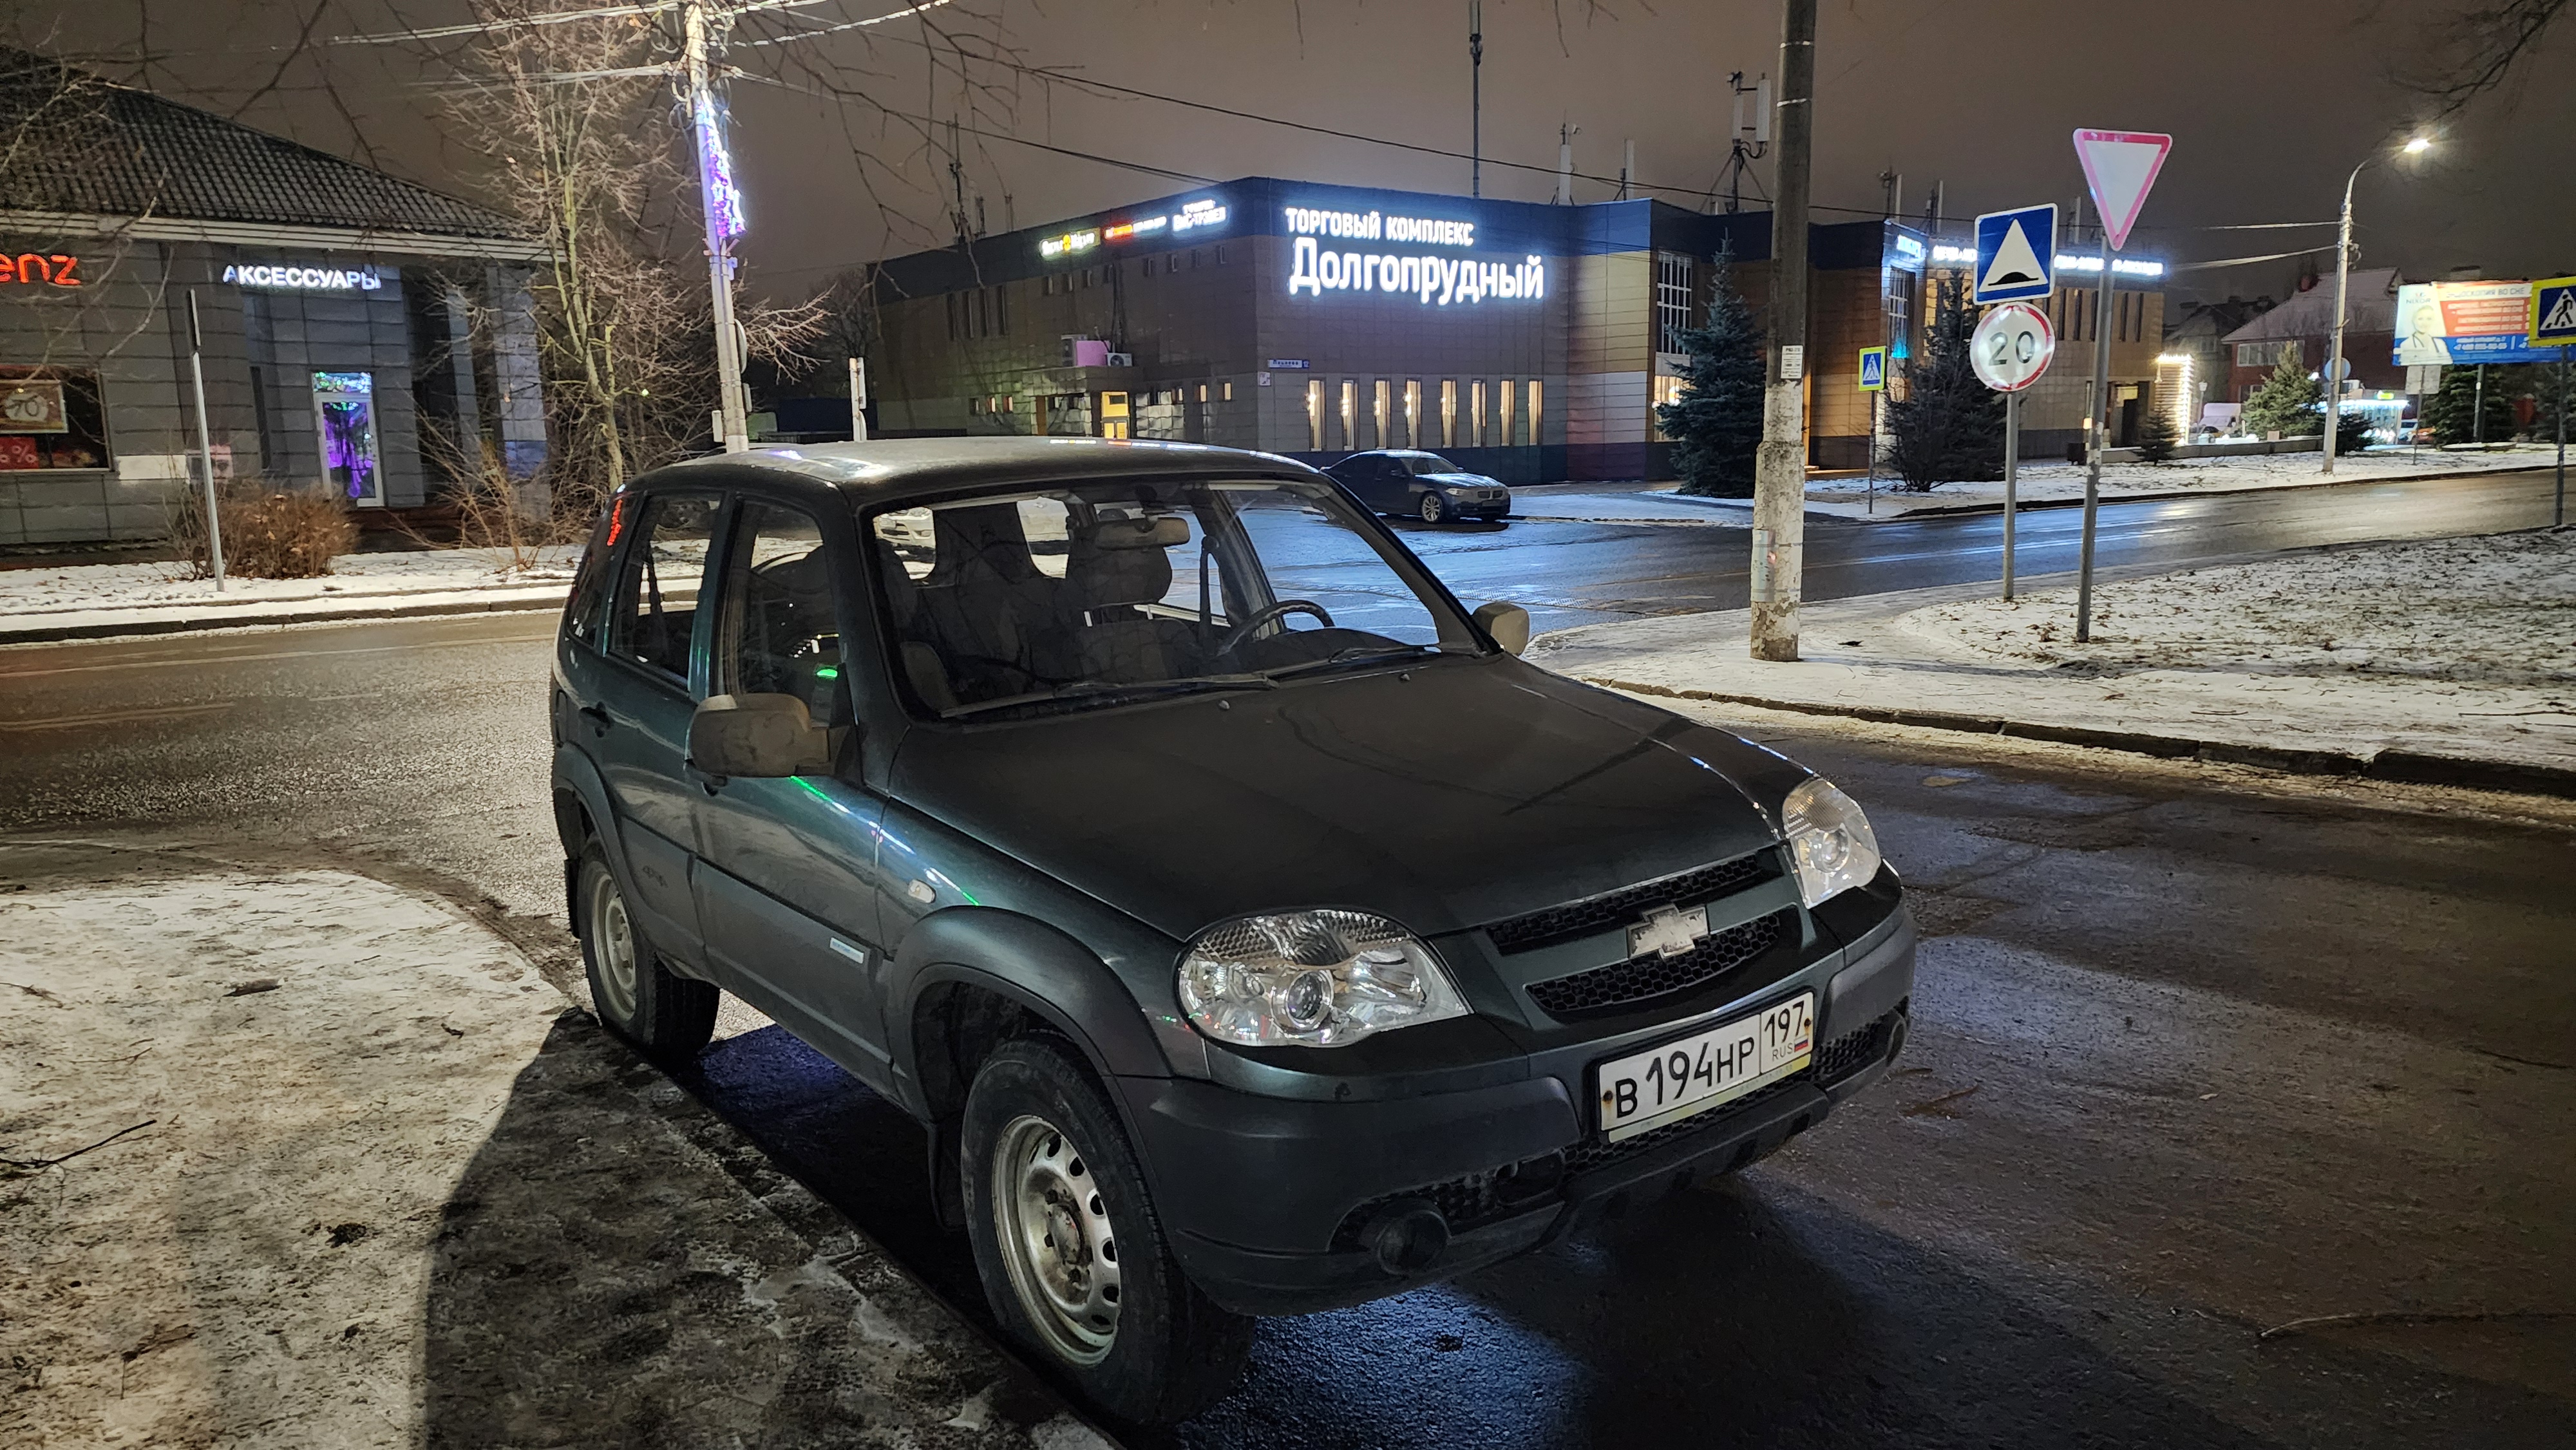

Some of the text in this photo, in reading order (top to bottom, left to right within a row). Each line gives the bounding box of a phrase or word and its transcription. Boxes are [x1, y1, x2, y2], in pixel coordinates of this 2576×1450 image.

[1285, 207, 1474, 246] ТОРГОВЫЙ КОМПЛЕКС
[223, 265, 381, 290] АКСЕССУАРЫ
[1288, 236, 1544, 306] Долгопрудный
[1989, 330, 2035, 366] 20
[1615, 1036, 1755, 1118] В194НР
[1764, 1000, 1805, 1048] 197
[1772, 1042, 1794, 1062] RUS
